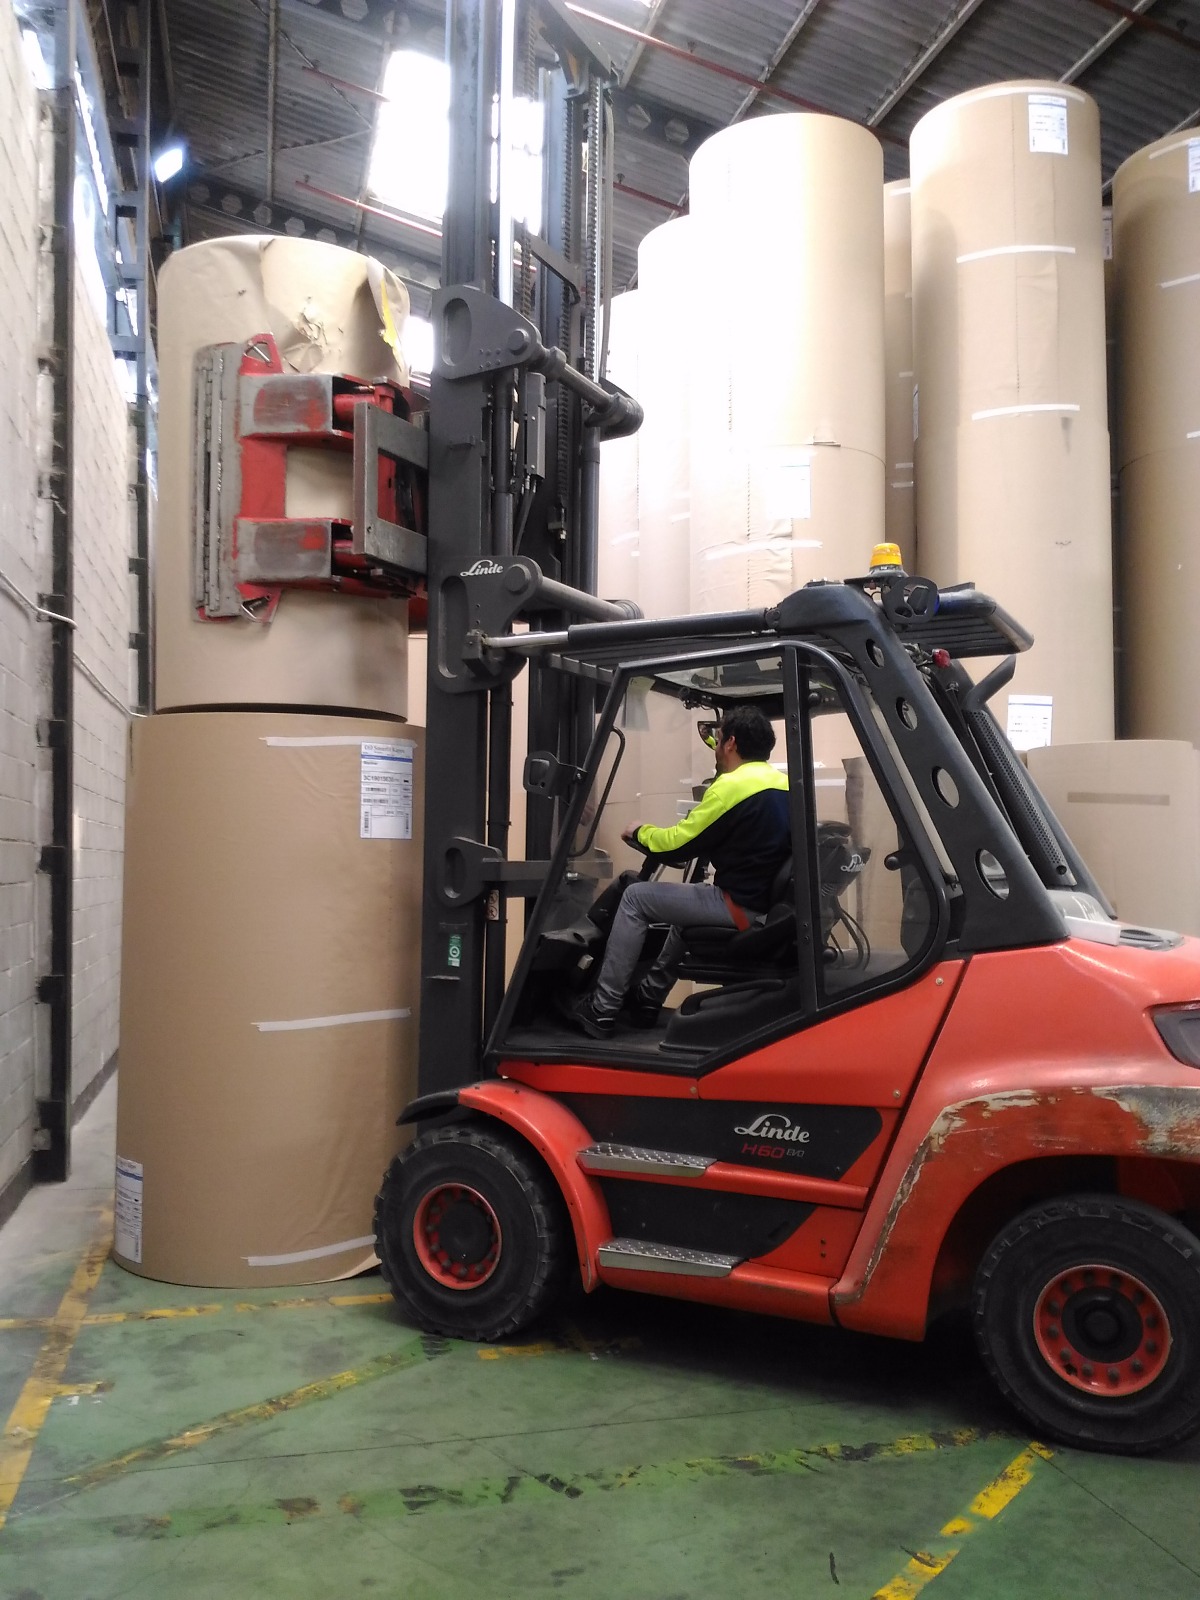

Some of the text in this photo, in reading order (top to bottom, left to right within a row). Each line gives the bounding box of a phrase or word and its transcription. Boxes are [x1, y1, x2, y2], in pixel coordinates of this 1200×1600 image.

[460, 559, 503, 577] Linde
[734, 1113, 810, 1143] Linde
[741, 1143, 785, 1159] H60
